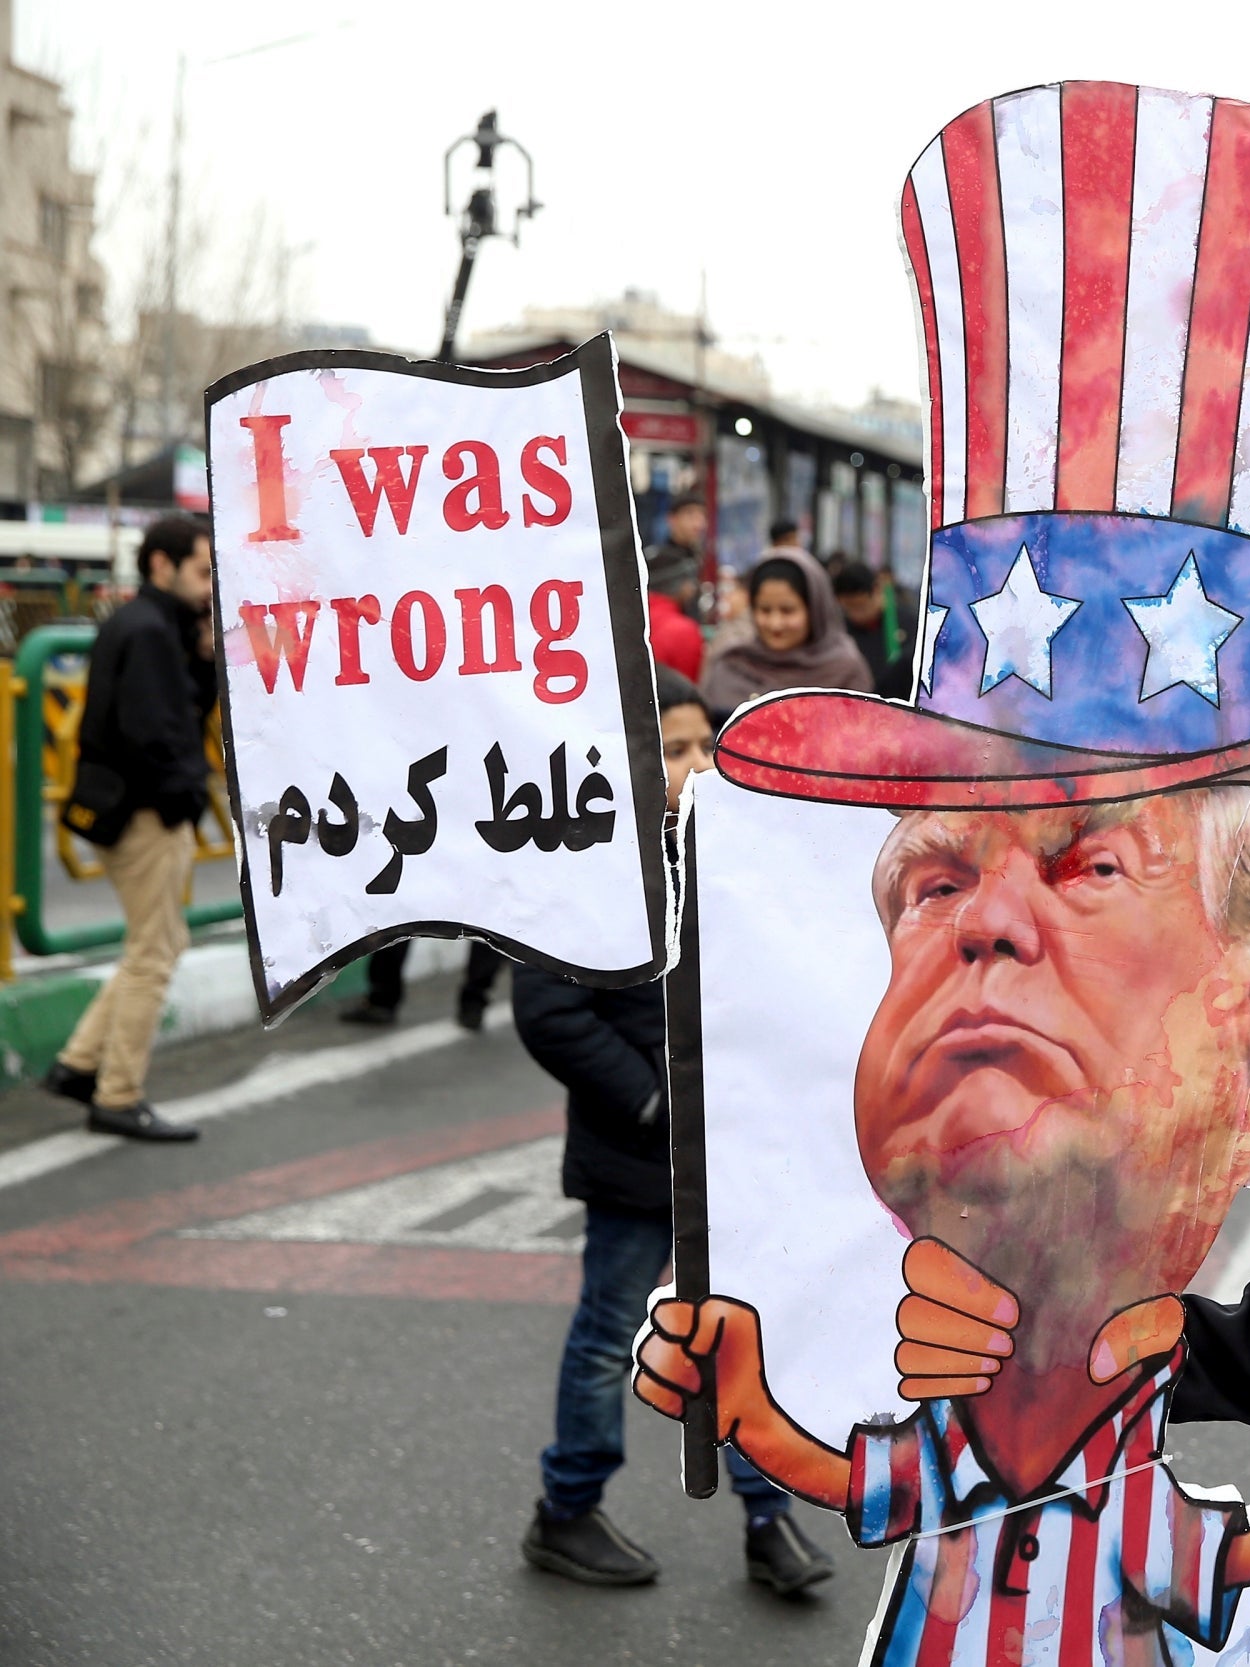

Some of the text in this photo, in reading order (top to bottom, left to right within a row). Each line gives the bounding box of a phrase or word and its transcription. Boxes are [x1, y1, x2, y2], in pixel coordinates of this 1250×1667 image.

[239, 414, 573, 543] I was
[239, 578, 589, 704] wrong
[266, 740, 617, 897] غلط کردم
